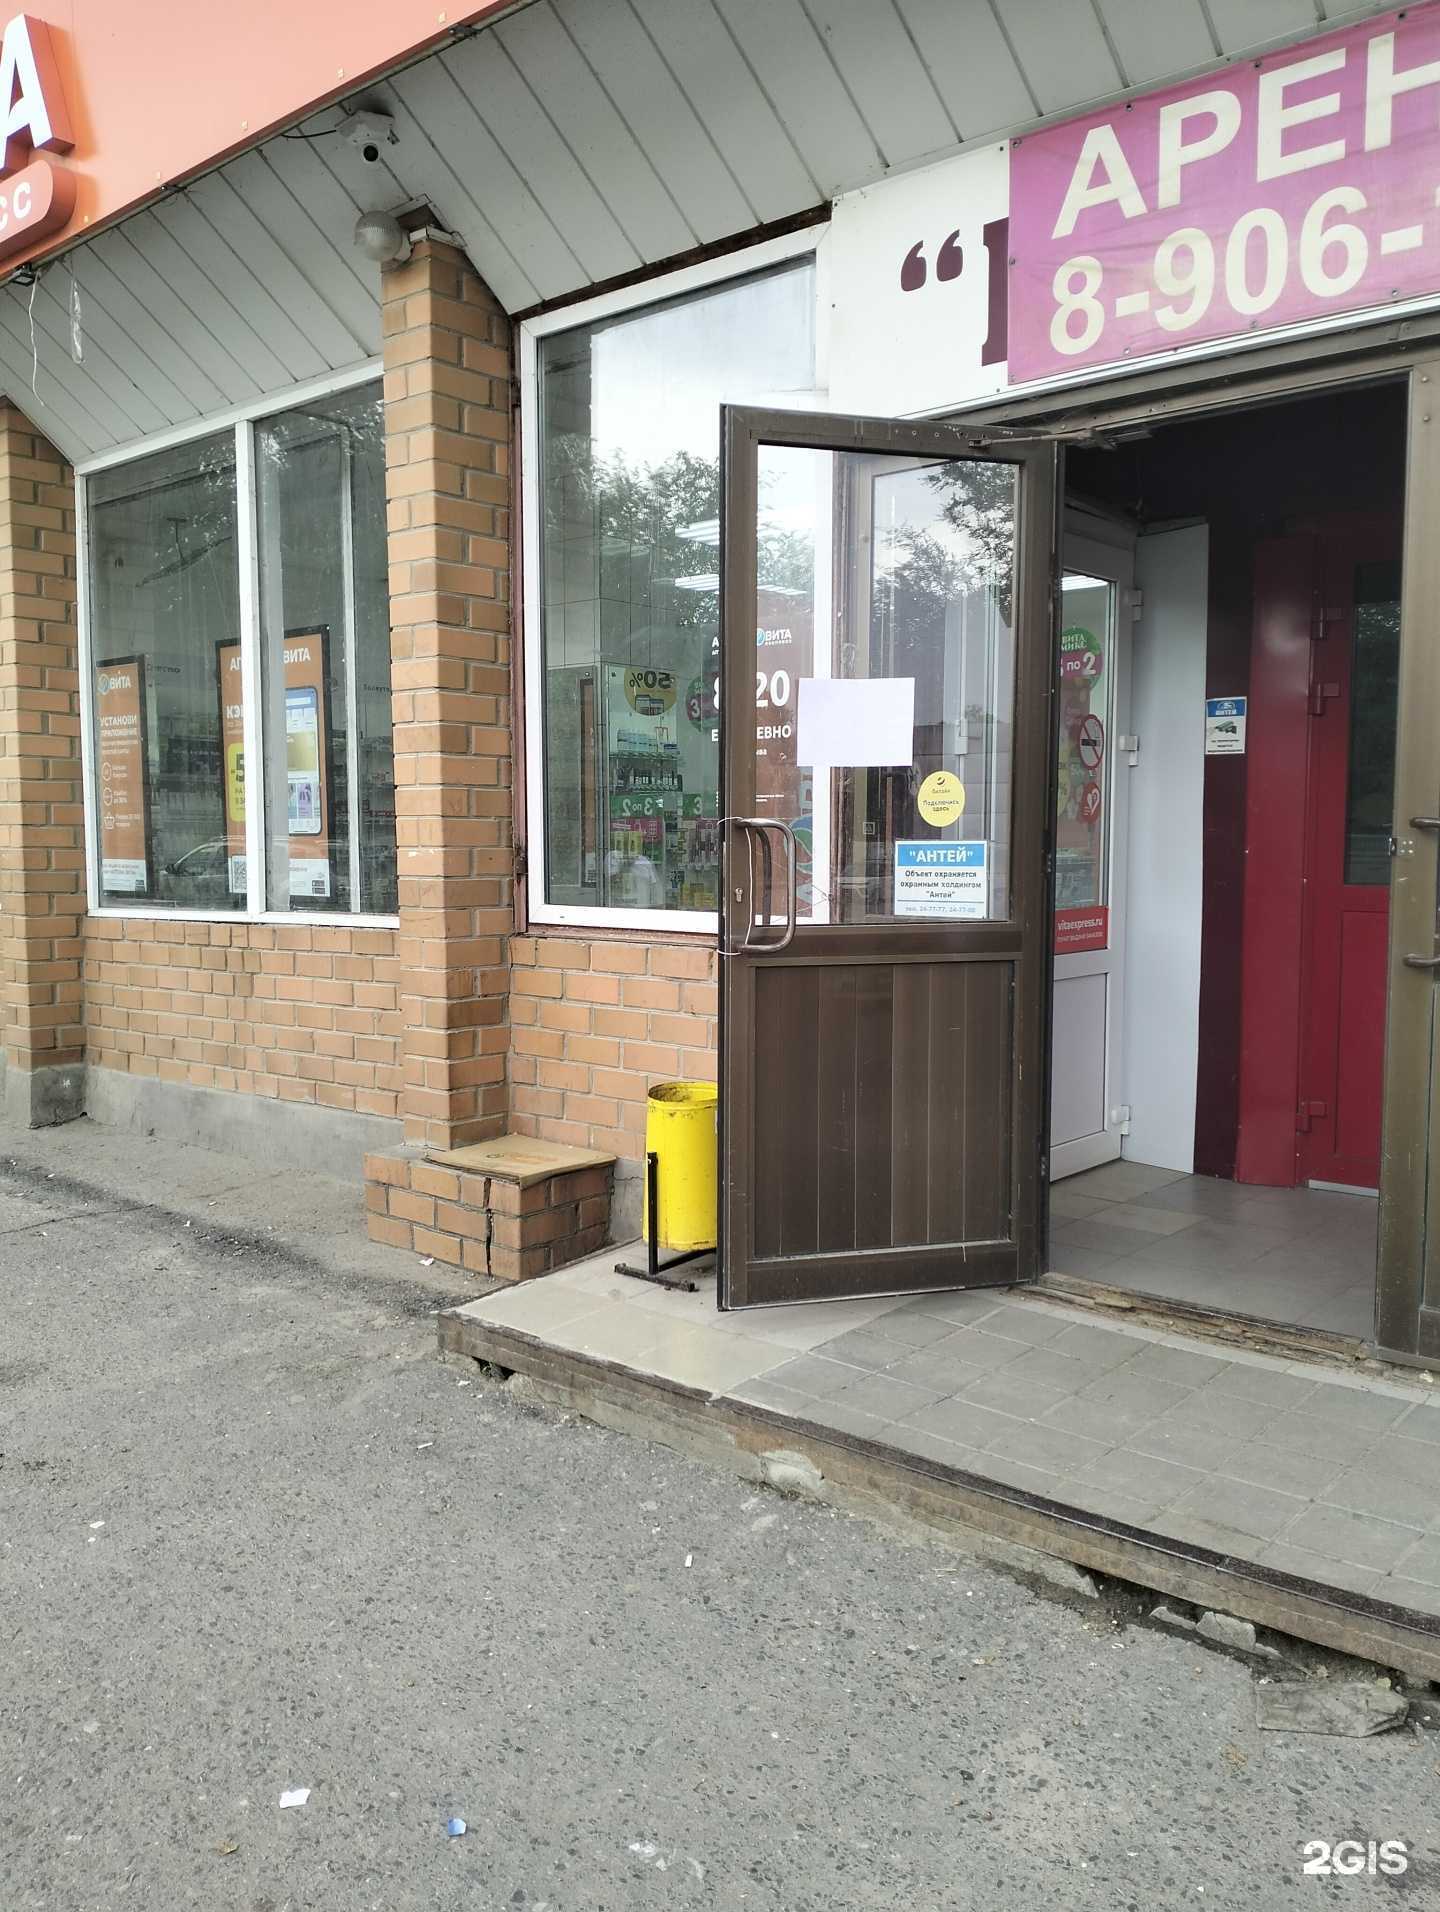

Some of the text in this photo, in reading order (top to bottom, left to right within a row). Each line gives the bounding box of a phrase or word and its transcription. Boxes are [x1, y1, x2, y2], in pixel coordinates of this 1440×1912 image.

[1049, 185, 1440, 355] 8-906-
[765, 629, 792, 640] ВИТА
[283, 648, 311, 664] ВИТА
[1083, 652, 1097, 675] 2
[226, 704, 244, 719] КЭ
[99, 713, 137, 727] УСТАНОВИ
[909, 846, 973, 863] "АНТЕЙ"
[905, 870, 977, 880] Объект охраняется
[900, 881, 982, 891] охранным холдингом
[925, 890, 956, 899] "Антей"
